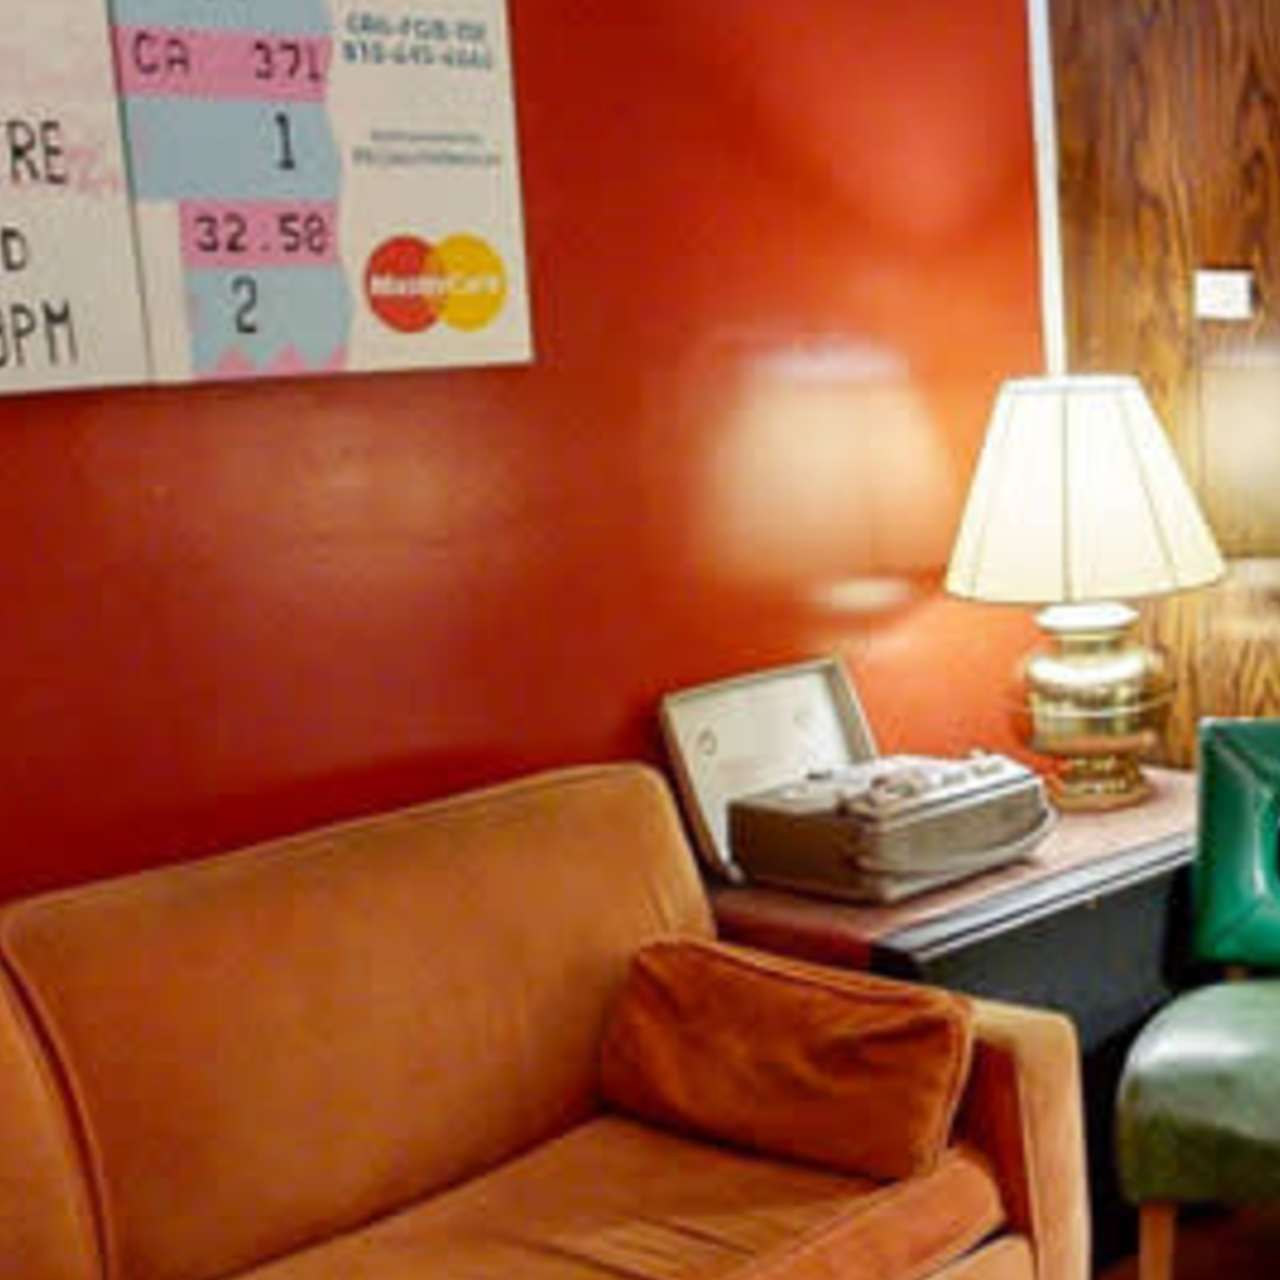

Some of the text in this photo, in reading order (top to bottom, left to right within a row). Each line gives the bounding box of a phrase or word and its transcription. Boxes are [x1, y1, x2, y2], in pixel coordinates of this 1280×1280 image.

[132, 32, 324, 84] CA 371
[274, 112, 296, 170] 1
[196, 216, 328, 256] 32.50
[230, 276, 260, 334] 2
